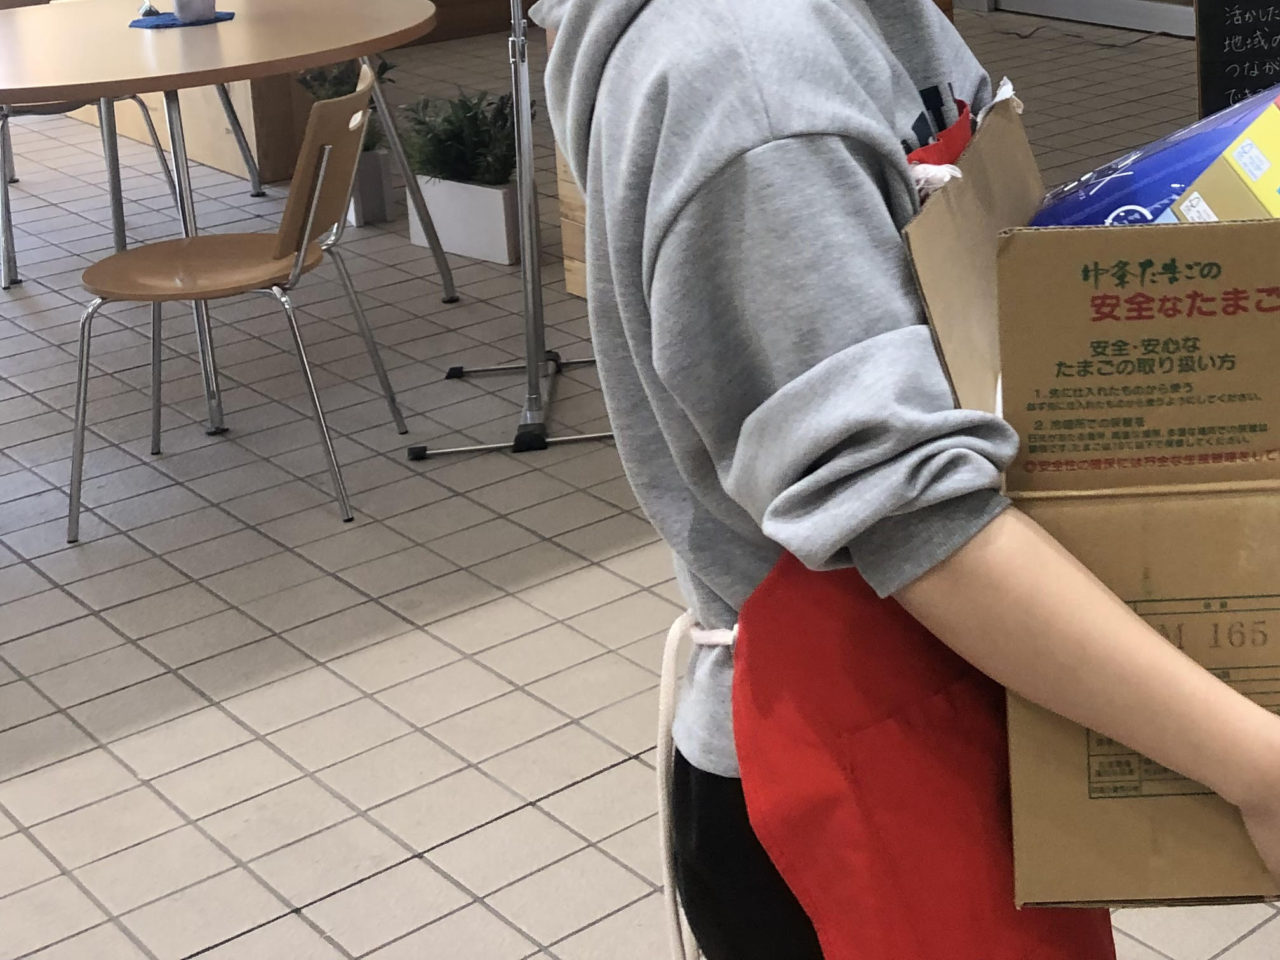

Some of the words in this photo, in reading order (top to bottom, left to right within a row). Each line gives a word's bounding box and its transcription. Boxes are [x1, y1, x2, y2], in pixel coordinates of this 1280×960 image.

[1090, 337, 1200, 358] 安全・安心な
[1056, 353, 1236, 378] たまごの取り扱い方
[1208, 620, 1268, 650] 165
